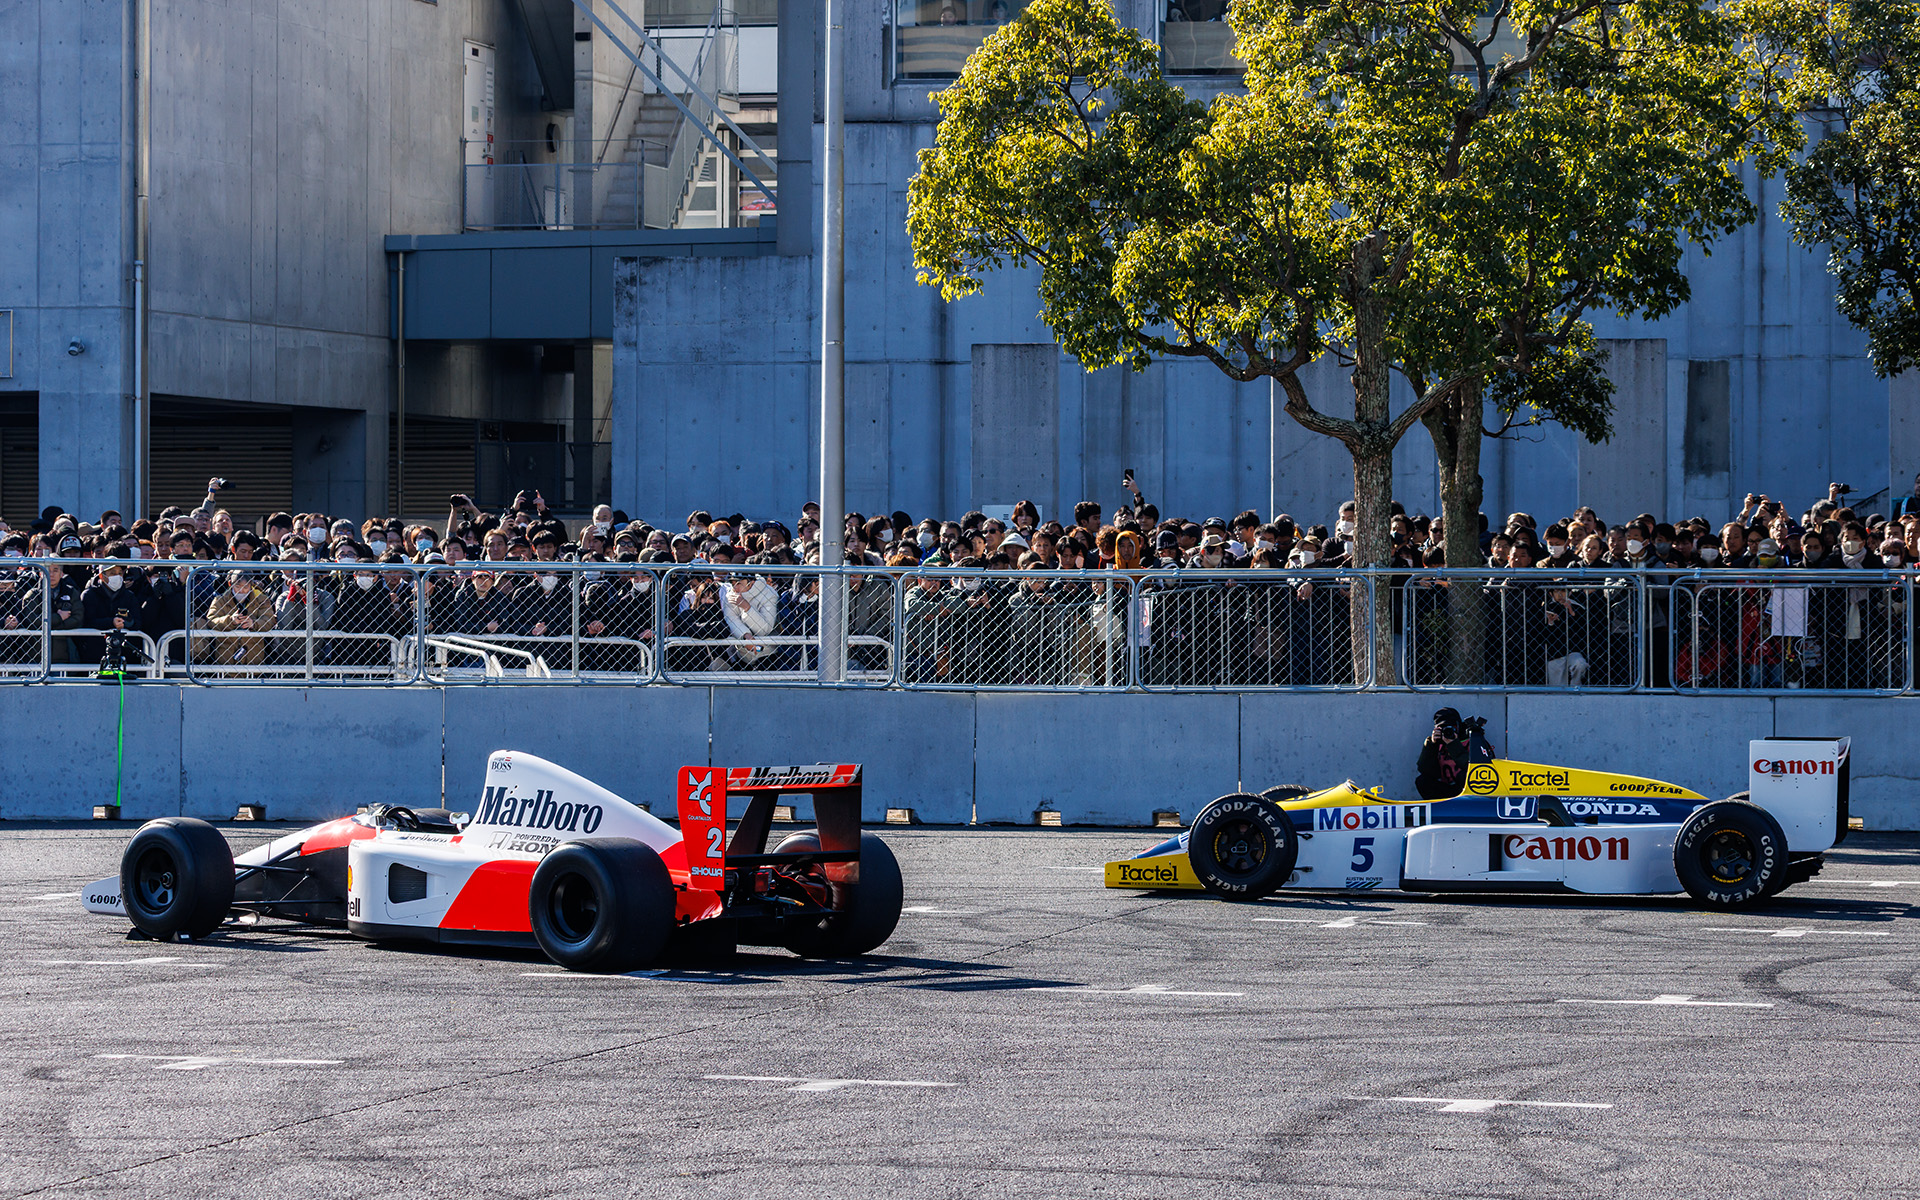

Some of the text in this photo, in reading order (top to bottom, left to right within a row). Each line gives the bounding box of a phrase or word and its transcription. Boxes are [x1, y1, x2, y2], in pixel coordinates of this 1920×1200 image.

[491, 761, 513, 771] BOSS
[747, 766, 830, 787] Marlboro
[1475, 770, 1492, 780] ICI
[1753, 759, 1835, 775] Canon
[1509, 770, 1570, 786] Tactel
[475, 786, 604, 835] Marlboro
[1320, 805, 1420, 830] Mobil 1
[1683, 813, 1716, 849] EAGLE
[706, 827, 723, 859] 2
[1503, 834, 1629, 861] Canon
[1350, 837, 1375, 873] 5
[691, 865, 723, 878] SHOWA
[1118, 864, 1179, 881] Tactel
[1206, 873, 1248, 893] EAGLE
[348, 897, 361, 918] ell
